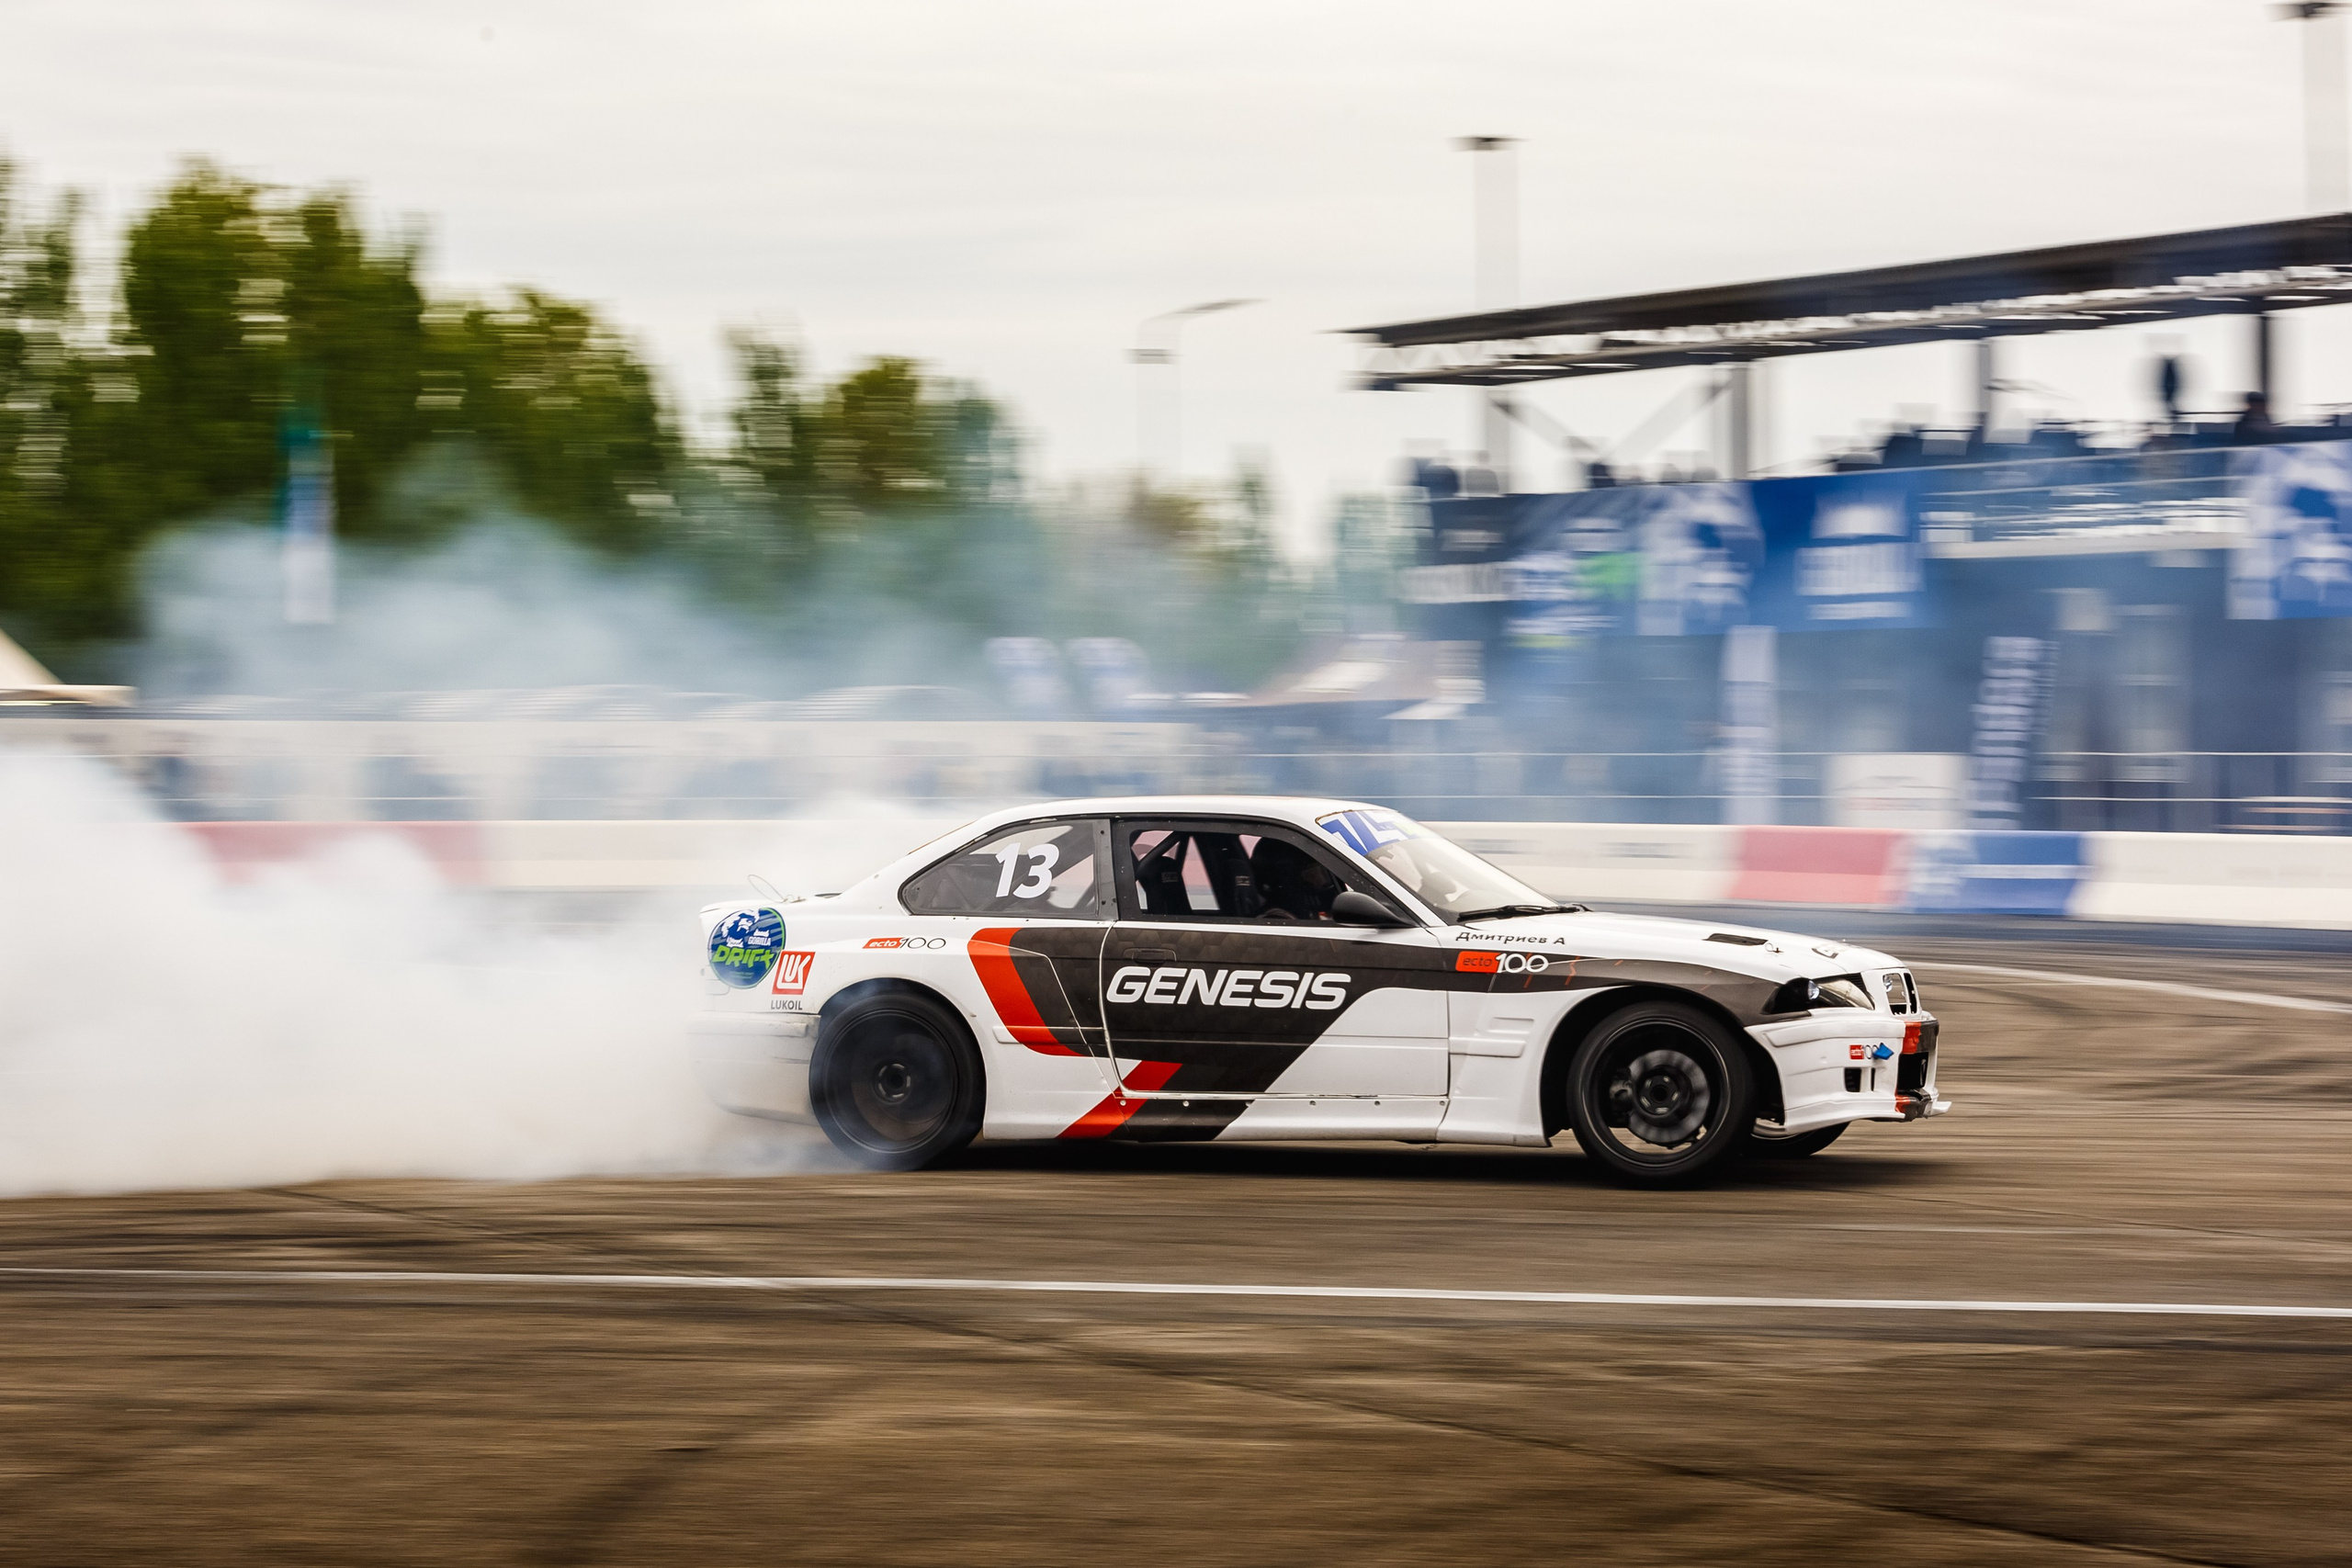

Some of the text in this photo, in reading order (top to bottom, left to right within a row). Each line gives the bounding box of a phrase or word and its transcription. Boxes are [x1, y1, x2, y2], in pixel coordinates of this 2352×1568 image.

[995, 842, 1060, 899] 13
[747, 936, 772, 946] GORILLA
[1455, 931, 1548, 944] Дмитриев
[1105, 965, 1352, 1010] GENESIS
[770, 999, 803, 1010] LUKOIL
